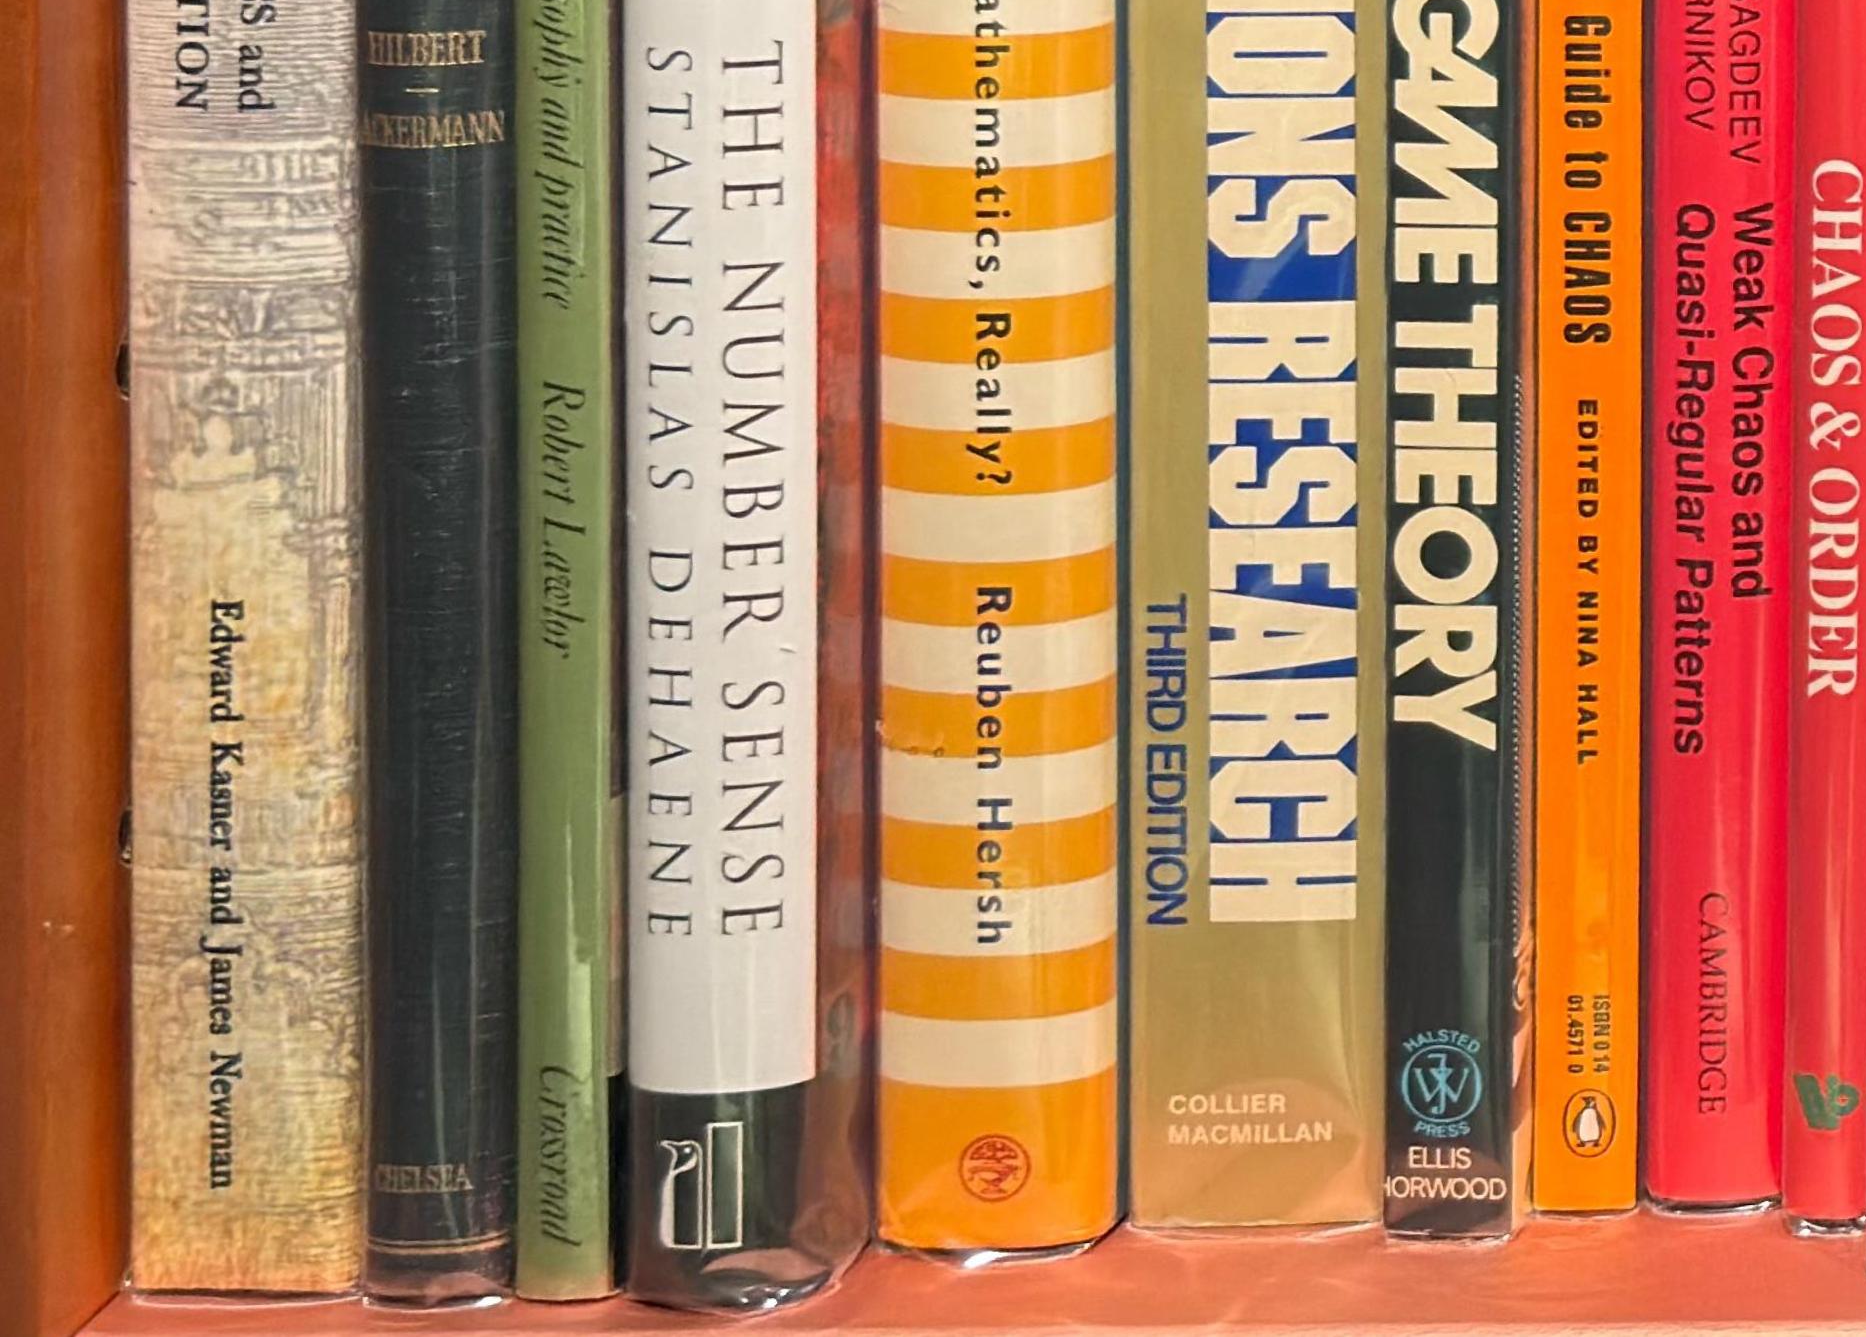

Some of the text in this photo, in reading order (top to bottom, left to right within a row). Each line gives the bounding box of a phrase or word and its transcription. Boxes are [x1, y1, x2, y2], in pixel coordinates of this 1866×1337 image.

[237, 43, 272, 112] and
[368, 30, 487, 66] HILBERT
[1563, 15, 1610, 129] Guide
[361, 110, 504, 149] ACKERMANN
[535, 97, 580, 166] and
[1563, 151, 1603, 189] to
[532, 169, 585, 310] practice
[1563, 211, 1610, 345] CHAOS
[966, 312, 1012, 487] Really?
[1731, 203, 1774, 598] Weak Chaos and
[1806, 161, 1865, 698] CHAOS ORDER
[543, 380, 586, 659] Robert Lawlor
[646, 46, 695, 937] STANISLAS DEHAENE
[720, 39, 786, 937] THE NUMBER SENSE
[1393, 304, 1498, 752] THEORY
[1668, 203, 1716, 755] Quasi-Regular Patterns
[1208, 301, 1358, 921] RESEARCH
[1577, 399, 1598, 764] EDITED BY NINA HALL
[975, 586, 1013, 945] Reuben Hersh
[1146, 592, 1188, 926] THIRD EDITION
[201, 601, 245, 1190] Edward Kasner and James Newman
[1402, 1029, 1480, 1053] HALSTED
[1593, 995, 1610, 1036] ISBN
[1700, 892, 1729, 1115] CAMBRIDGE
[373, 1165, 473, 1192] CHELSEA
[537, 1064, 589, 1248] Crossroad
[1168, 1093, 1286, 1115] COLLIER
[1168, 1121, 1332, 1145] MACMILLAN
[1408, 1146, 1472, 1170] ELLIS
[1414, 1121, 1471, 1137] PRESS
